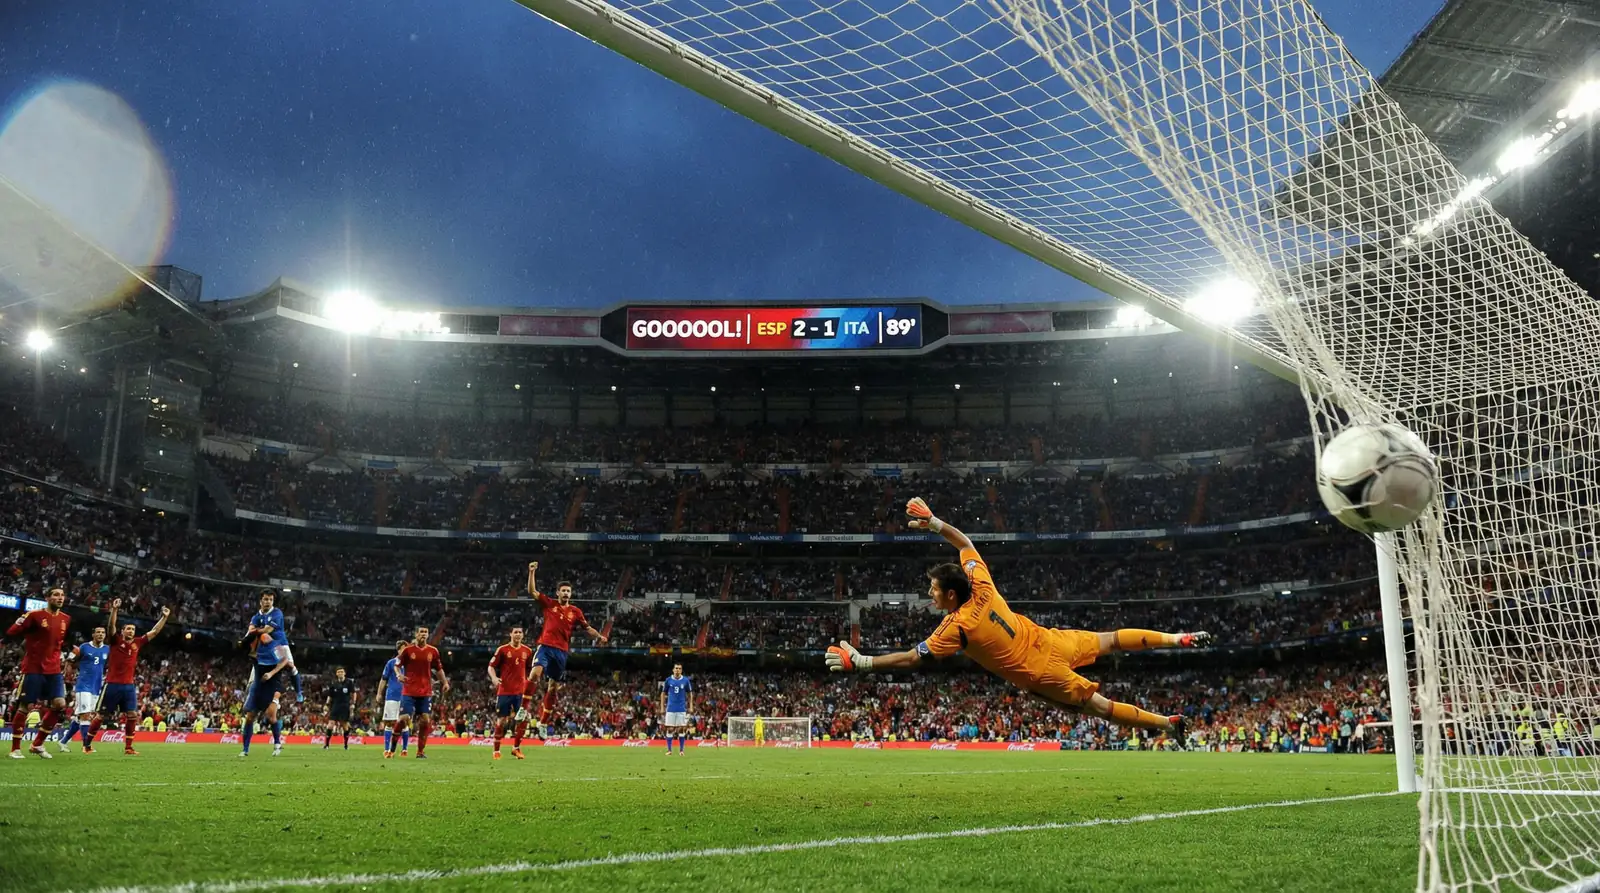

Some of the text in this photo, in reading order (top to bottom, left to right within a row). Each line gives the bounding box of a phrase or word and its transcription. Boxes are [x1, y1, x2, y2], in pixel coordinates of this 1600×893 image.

[632, 320, 742, 338] GOOOOOL!
[757, 322, 788, 335] ESP
[793, 320, 806, 337] 2
[824, 320, 835, 337] 1
[844, 321, 870, 335] ITA
[886, 318, 917, 336] 89'
[989, 609, 1016, 641] 1
